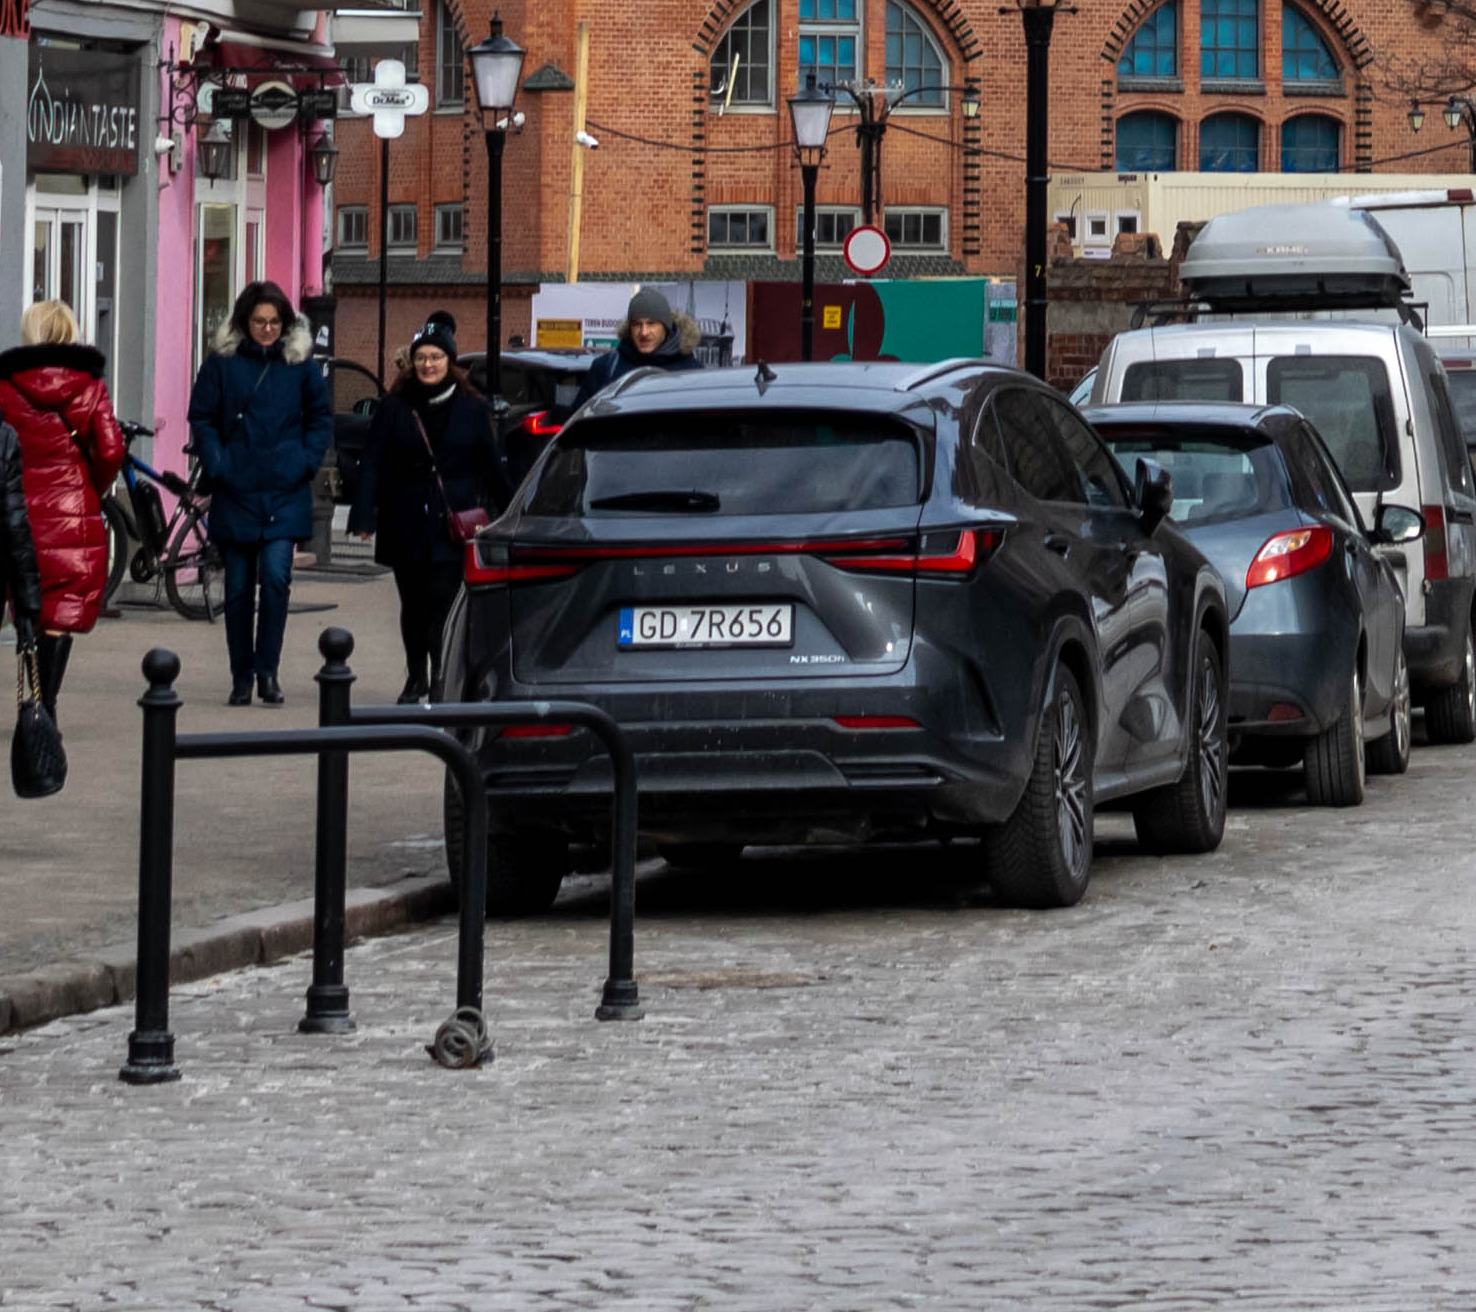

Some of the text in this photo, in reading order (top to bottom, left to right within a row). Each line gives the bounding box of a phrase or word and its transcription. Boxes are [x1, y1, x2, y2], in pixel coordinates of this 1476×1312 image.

[91, 103, 136, 150] TASTE
[633, 561, 771, 576] LEXUS
[639, 608, 783, 640] GD 7R656
[789, 655, 808, 663] NX
